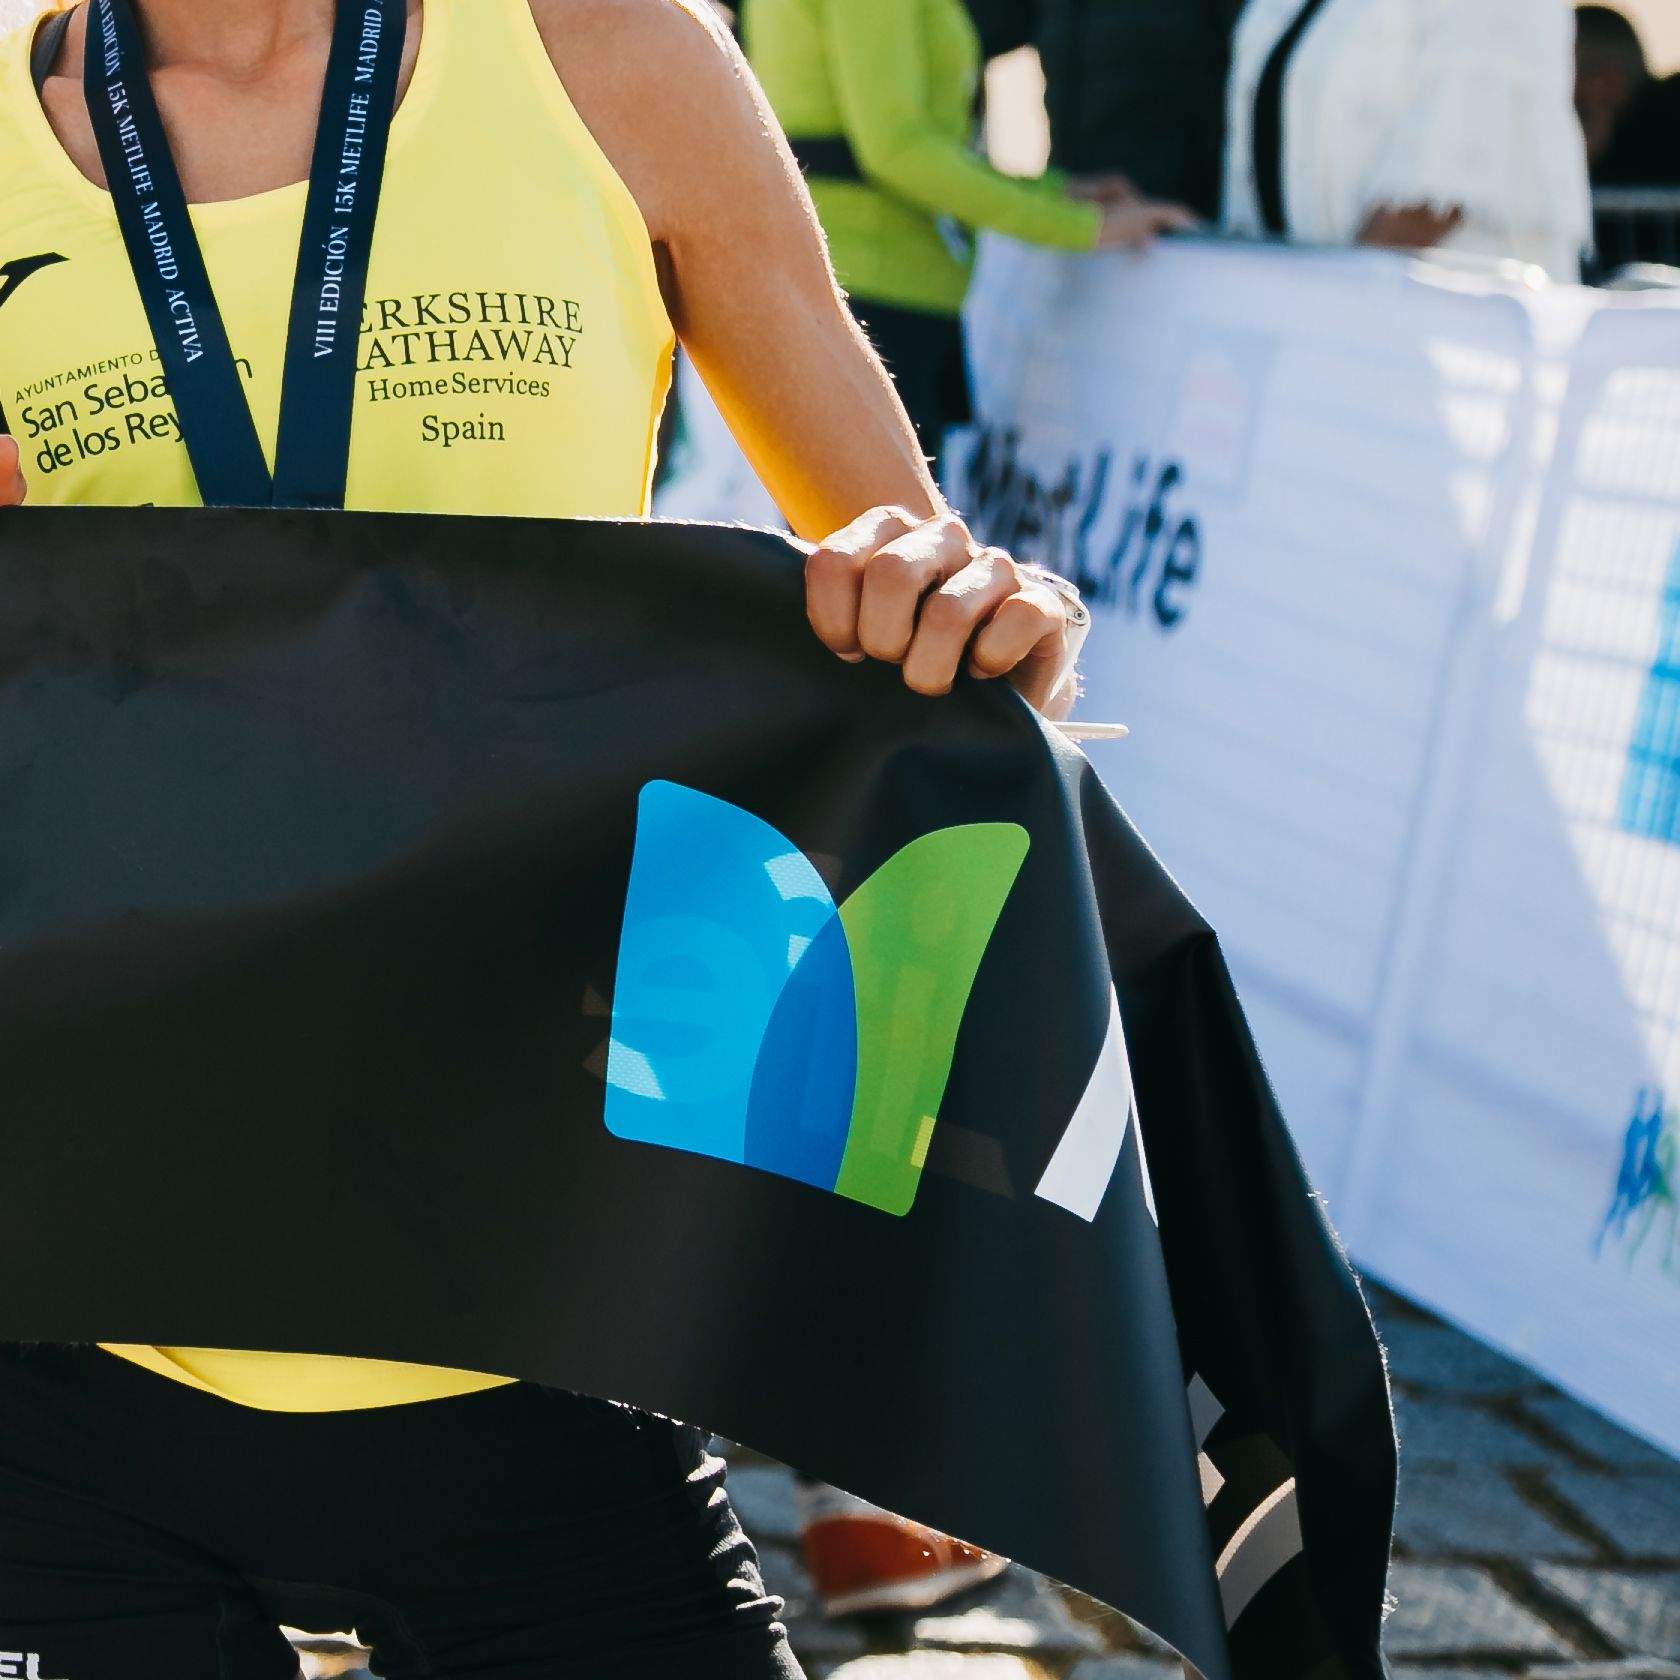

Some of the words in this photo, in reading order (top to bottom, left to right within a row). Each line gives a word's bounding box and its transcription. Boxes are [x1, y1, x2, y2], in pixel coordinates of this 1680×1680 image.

[101, 10, 125, 78] EDICIÓN
[354, 7, 384, 86] MADRID
[106, 80, 131, 116] 15K
[117, 115, 154, 196] METLIFE
[342, 92, 371, 178] METLIFE
[334, 180, 358, 216] 15K
[141, 203, 179, 282] MADRID
[320, 225, 350, 314] EDICIÓN
[166, 288, 205, 365] ACTIVA
[313, 314, 337, 360] VIII
[359, 292, 583, 334] ERKSHIRE
[356, 329, 577, 372] ATHAWAY
[15, 352, 144, 405] AYUNTAMIENTO
[21, 398, 79, 439] San
[422, 412, 506, 448] Spain
[36, 437, 74, 475] de
[71, 425, 122, 460] los
